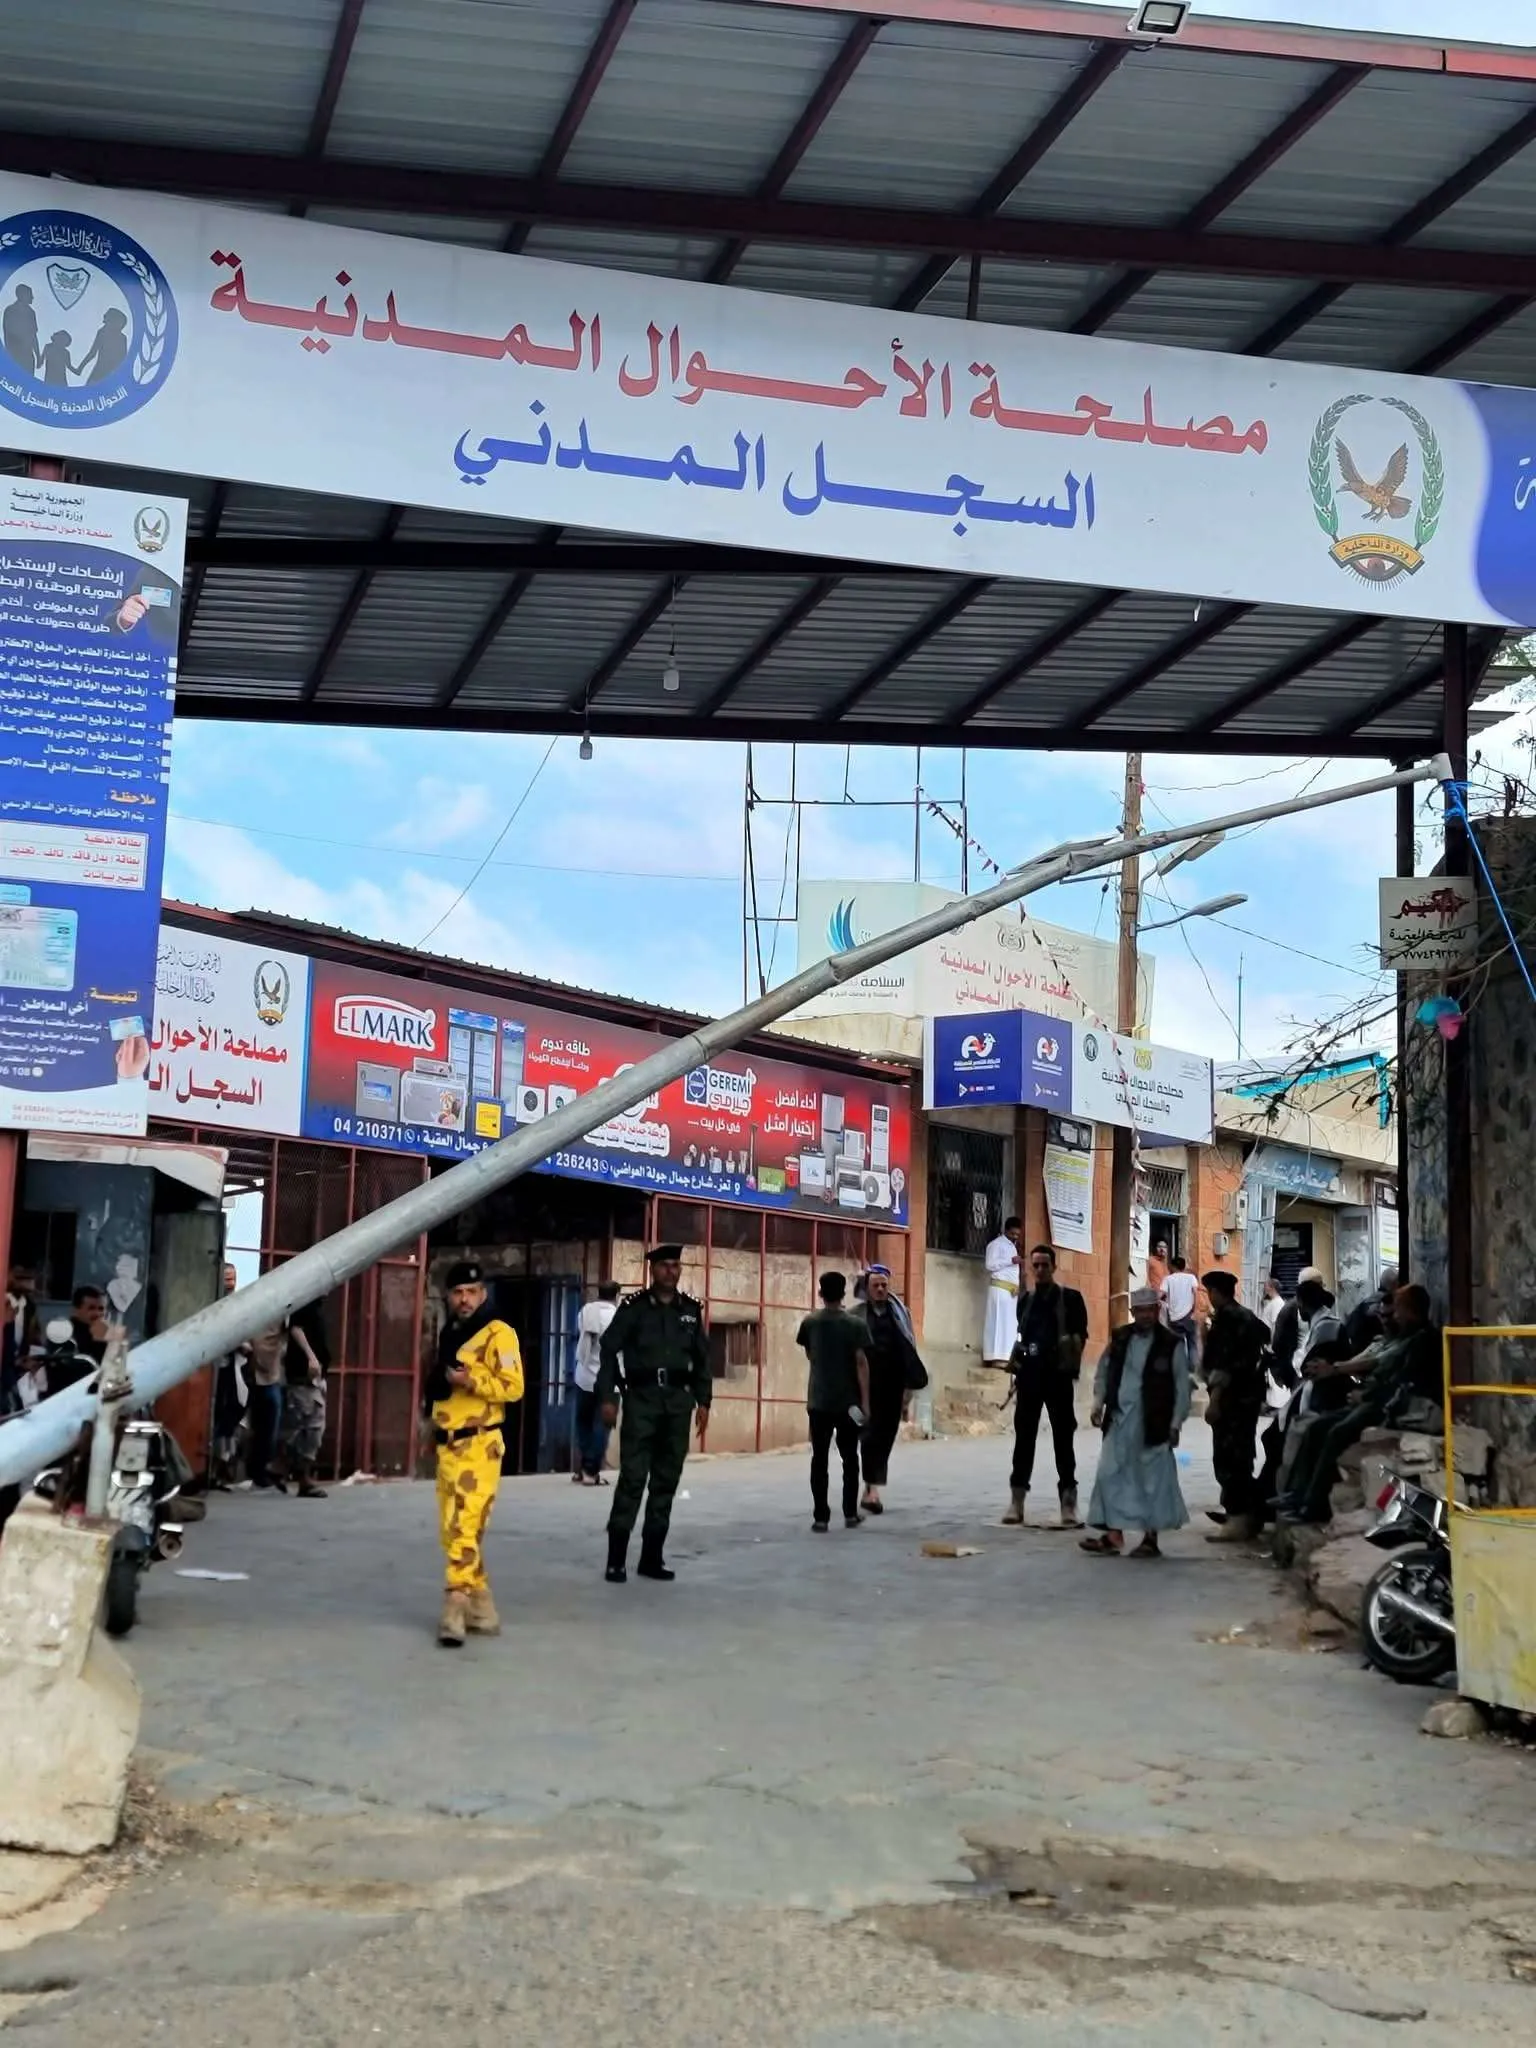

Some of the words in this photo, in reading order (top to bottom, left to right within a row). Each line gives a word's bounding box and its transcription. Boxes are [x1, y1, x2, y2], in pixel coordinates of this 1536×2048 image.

[209, 249, 601, 374] المدنية
[618, 320, 952, 420] الأحوال
[21, 391, 59, 413] والسجل
[61, 399, 95, 415] المدنية
[969, 362, 1269, 456] مصلحة
[453, 400, 766, 492] المدني
[782, 440, 1096, 537] السجل
[58, 564, 124, 587] إرشادات
[35, 579, 81, 595] الوطنية
[82, 586, 123, 600] الهوية
[33, 600, 73, 613] المواطن
[75, 604, 99, 617] أخي
[36, 616, 76, 629] حصولك
[77, 623, 110, 634] طريقة
[940, 946, 991, 976] المدنية
[860, 976, 905, 988] السلامة
[955, 979, 1005, 1005] المدني
[20, 998, 67, 1012] المواطن
[338, 1001, 432, 1047] ELMARK
[223, 1028, 288, 1064] مصلحة
[540, 1038, 563, 1053] تدوم
[175, 1066, 263, 1110] السجل
[709, 1073, 750, 1095] GEREMI
[1157, 1082, 1184, 1099] مصلحة
[774, 1088, 799, 1108] أفضل
[333, 1117, 351, 1135] 04
[356, 1121, 402, 1141] 210371
[700, 1116, 714, 1130] بيت
[715, 1118, 726, 1132] كل
[727, 1122, 741, 1135] في
[423, 1129, 453, 1148] العقبة
[556, 1152, 600, 1172] 236243
[646, 1165, 668, 1184] جولة
[669, 1171, 691, 1188] جمال
[691, 1175, 714, 1190] شارع
[717, 1178, 732, 1194] تعز
